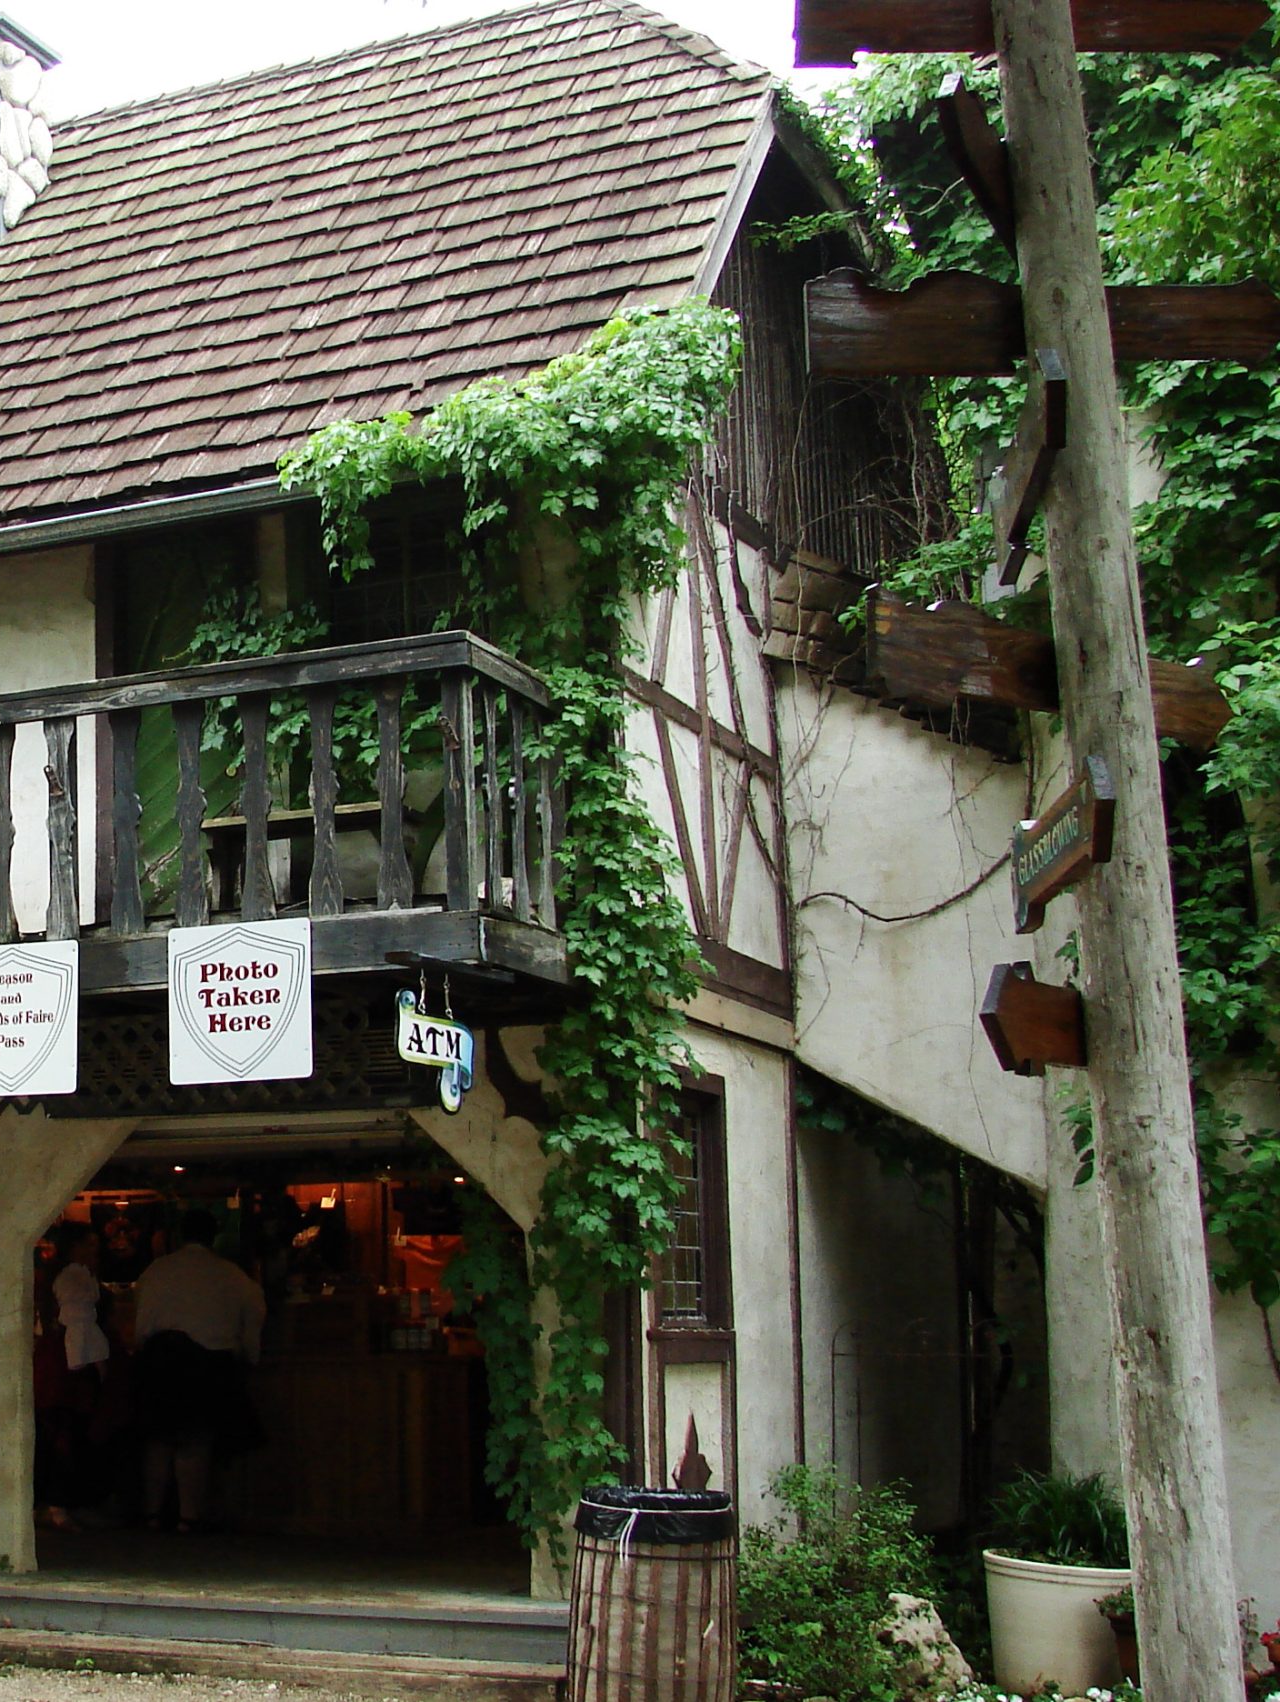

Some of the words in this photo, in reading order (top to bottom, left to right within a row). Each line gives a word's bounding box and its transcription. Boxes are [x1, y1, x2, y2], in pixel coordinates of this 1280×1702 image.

[200, 960, 278, 983] Photo
[0, 992, 22, 1004] and
[198, 986, 281, 1008] Taken
[12, 1011, 24, 1024] of
[25, 1009, 54, 1023] Faire
[208, 1012, 271, 1033] Here
[406, 1022, 462, 1060] ATM
